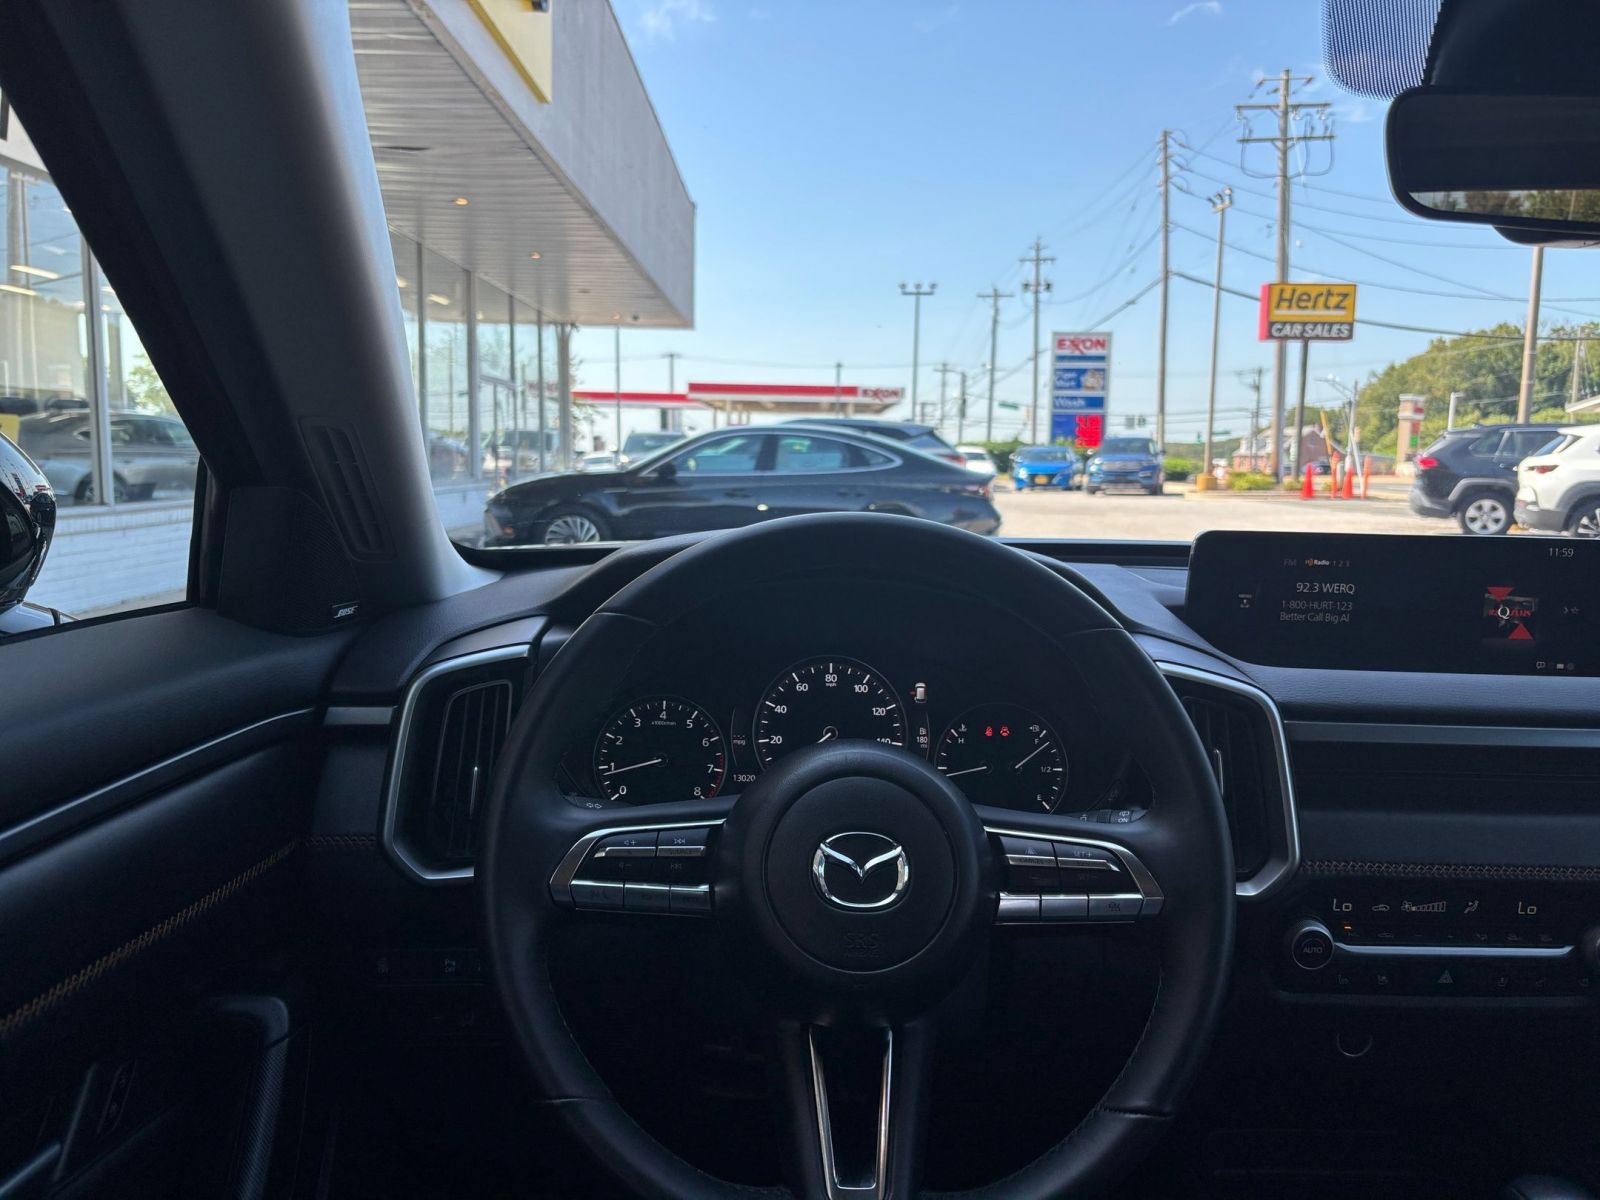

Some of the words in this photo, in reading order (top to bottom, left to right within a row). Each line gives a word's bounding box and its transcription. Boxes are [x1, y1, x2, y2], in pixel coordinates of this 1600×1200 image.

[1275, 287, 1349, 310] Hertz
[1271, 323, 1302, 337] CAR
[1303, 323, 1349, 337] SALES
[1057, 337, 1106, 354] EXXON
[862, 388, 899, 400] EXXON
[1549, 547, 1574, 558] 11:59
[1296, 582, 1319, 593] 92.3
[1322, 583, 1355, 595] WERQ
[1282, 599, 1352, 611] 1-800-HURT-123
[1280, 611, 1306, 621] Better
[1307, 612, 1323, 622] Call
[1325, 613, 1338, 624] Big
[1339, 613, 1350, 623] Al
[825, 673, 837, 683] 80
[796, 683, 808, 692] 60
[854, 684, 868, 693] 100
[774, 705, 787, 714] 40
[872, 707, 886, 716] 120
[659, 711, 667, 719] 4
[634, 718, 641, 728] 3
[686, 719, 693, 729] 5
[616, 736, 623, 745] 2
[702, 738, 710, 747] 6
[770, 736, 783, 744] 20
[609, 762, 615, 771] 1
[707, 764, 714, 773] 7
[733, 774, 756, 783] 13020
[619, 786, 627, 795] 0
[694, 787, 701, 796] 8
[1332, 898, 1353, 912] Lo
[1517, 901, 1537, 915] Lo
[1303, 945, 1323, 954] AUTO
